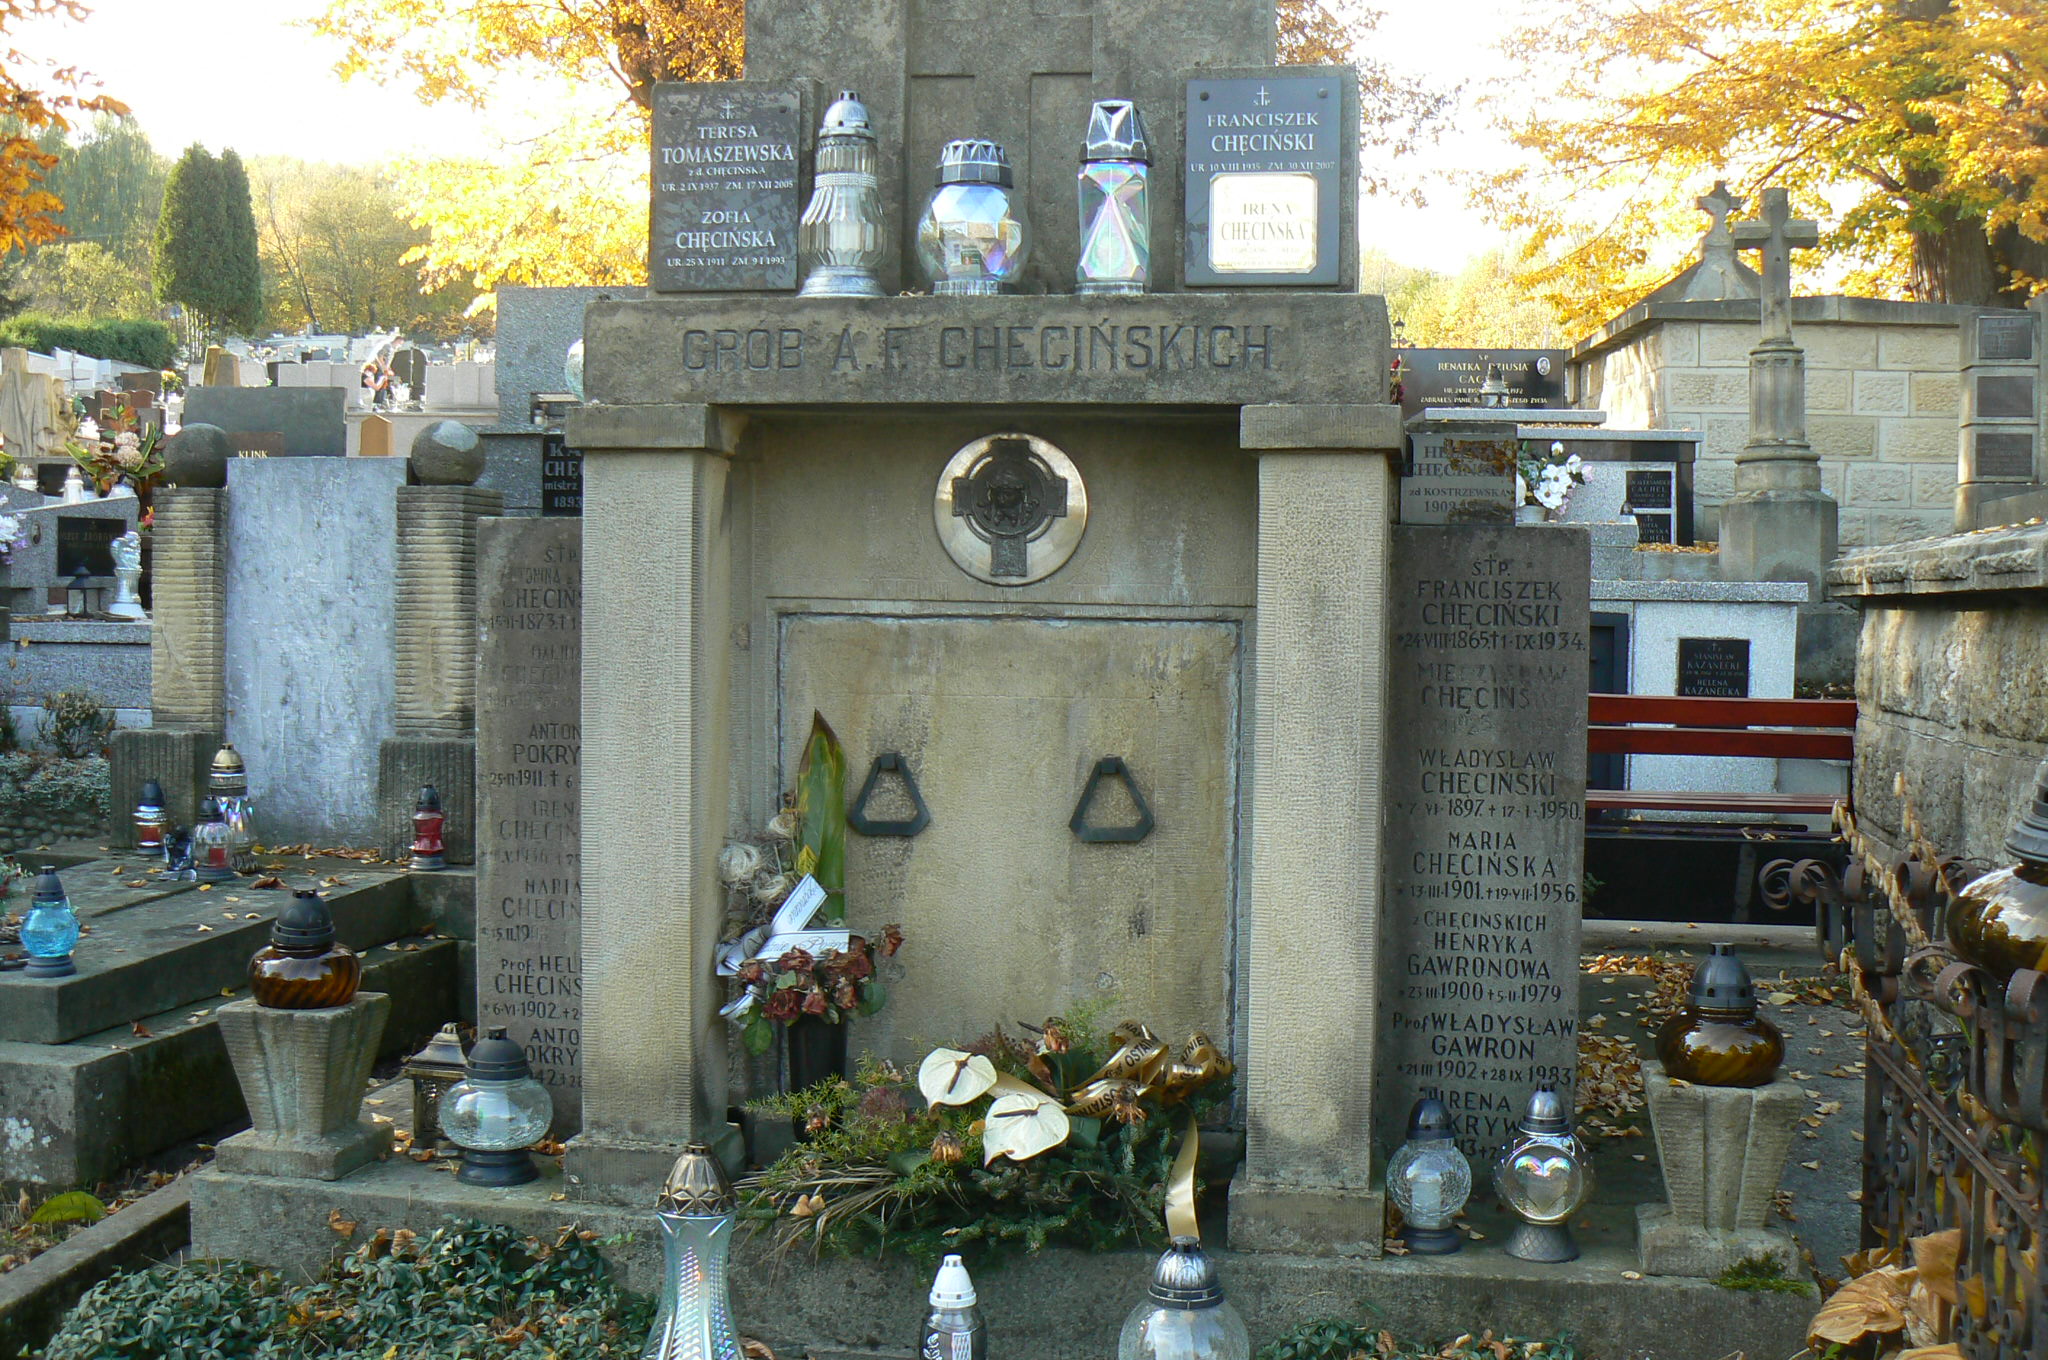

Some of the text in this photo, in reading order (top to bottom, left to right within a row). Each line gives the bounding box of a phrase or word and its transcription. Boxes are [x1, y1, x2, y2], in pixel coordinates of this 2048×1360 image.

[1207, 112, 1319, 127] FRANCISZEK
[698, 125, 758, 139] TERESA
[1211, 129, 1314, 156] CHĘCIŃSKI
[661, 144, 795, 164] TOMASZEWSKA
[702, 210, 751, 224] ZOFIA
[1243, 203, 1292, 215] IRENA
[676, 227, 776, 252] CHĘCIŃSKA
[1438, 362, 1481, 371] RENATKA
[544, 461, 579, 479] CHĘ
[1417, 580, 1562, 601] FRANCISZEK
[1422, 601, 1559, 630] CHĘCIŃSKI
[529, 723, 581, 739] ANTON
[512, 743, 581, 765] POKRY
[1419, 749, 1555, 769] WŁADYSŁAW
[1421, 771, 1556, 798] CHĘCIŃSKI
[533, 800, 581, 817] IREN
[1448, 831, 1517, 850] MARIA
[1413, 852, 1556, 878] CHĘCIŃSKA
[1434, 932, 1533, 954] HENRYKA
[540, 955, 582, 973] HEL
[1408, 954, 1550, 980] GAWRONOWA
[495, 973, 582, 998] CHĘCIŃS
[1431, 1012, 1574, 1037] WŁADYSŁAW
[530, 1028, 580, 1045] ANTO
[524, 1044, 578, 1066] OKRY
[1431, 1035, 1534, 1060] GAWRON
[1437, 1061, 1477, 1080] 1902
[1440, 1090, 1512, 1113] IRENA
[1450, 1113, 1521, 1137] KRYW
